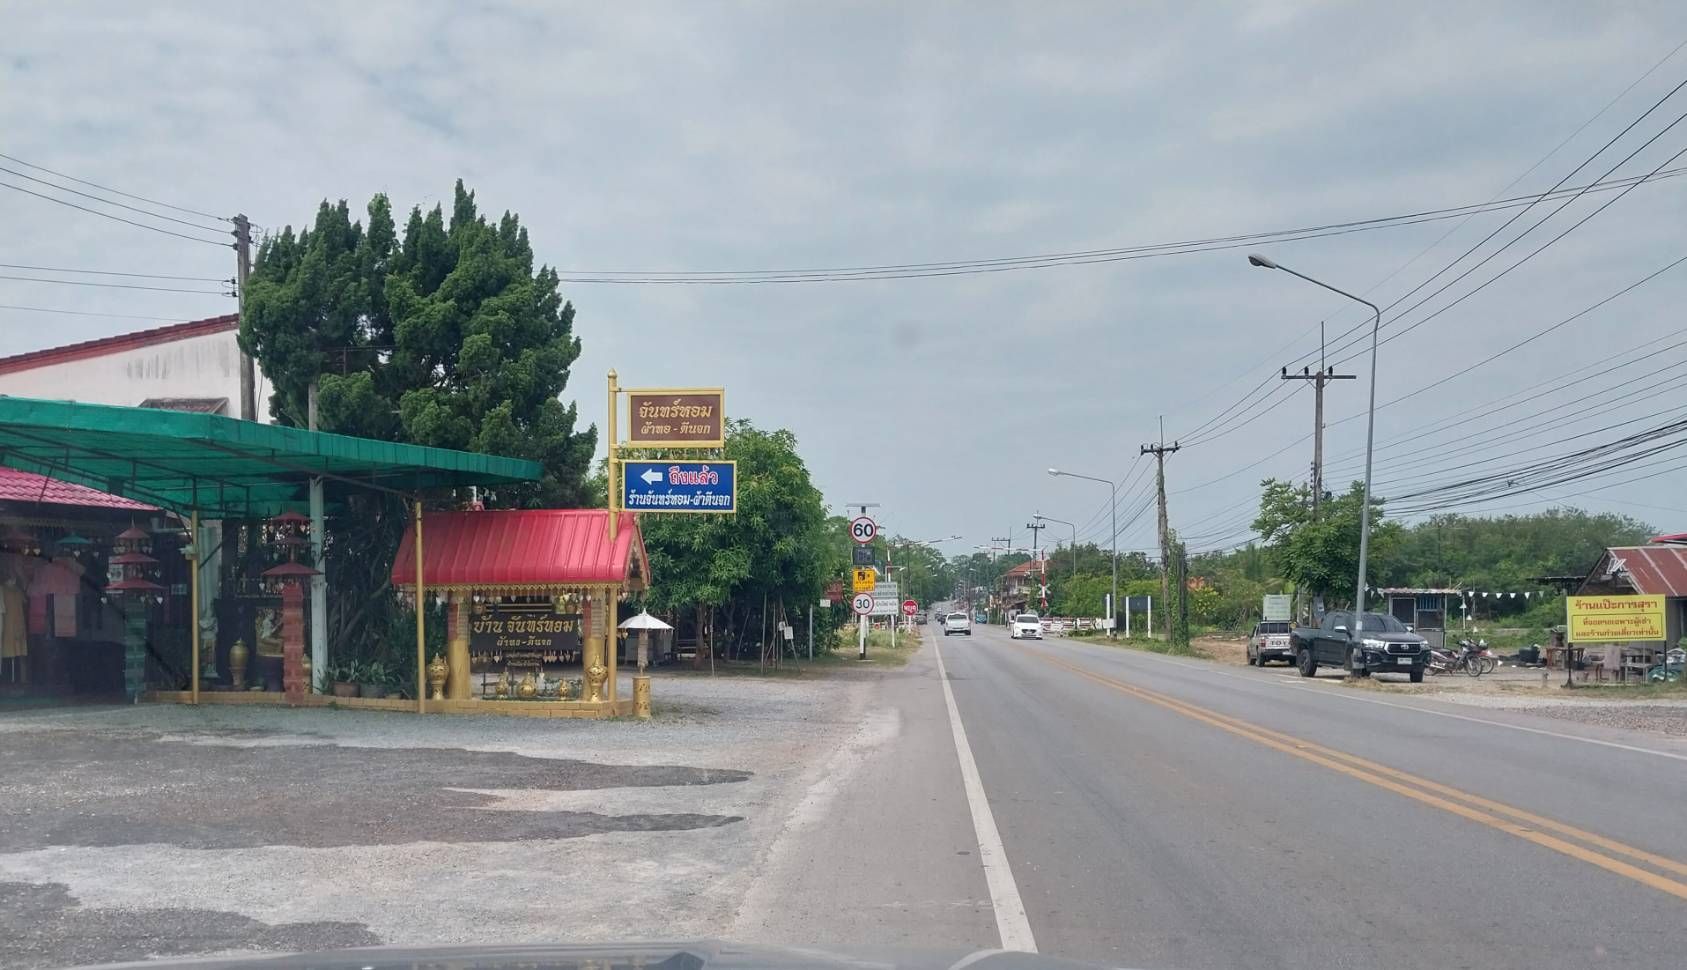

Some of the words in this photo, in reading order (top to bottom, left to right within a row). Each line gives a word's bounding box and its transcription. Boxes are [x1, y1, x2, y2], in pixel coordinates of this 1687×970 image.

[639, 399, 712, 418] จันทร์หอม
[679, 421, 711, 434] ตีนจก
[668, 465, 719, 485] ถึงแล้ว
[853, 523, 874, 537] 60
[855, 600, 870, 609] 30
[474, 614, 503, 634] บ้าน
[507, 614, 574, 634] จันทร์หอม
